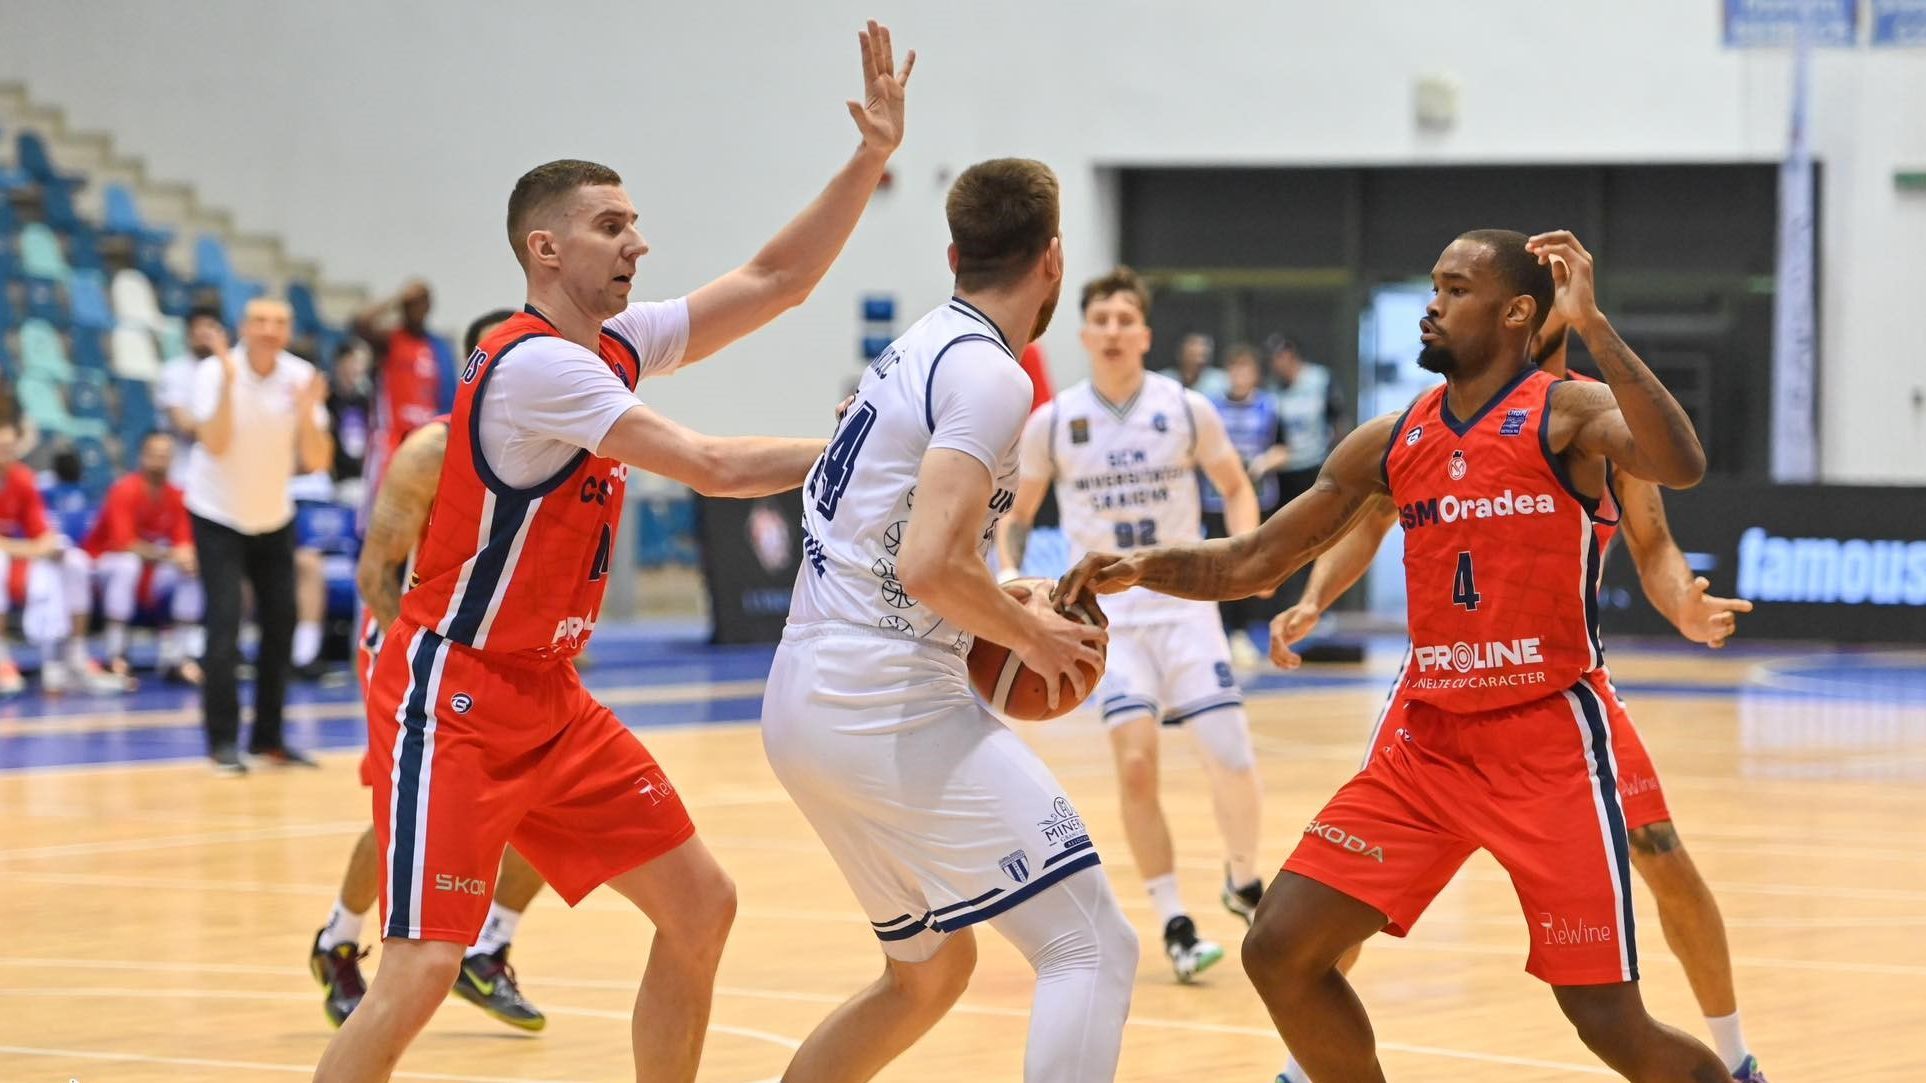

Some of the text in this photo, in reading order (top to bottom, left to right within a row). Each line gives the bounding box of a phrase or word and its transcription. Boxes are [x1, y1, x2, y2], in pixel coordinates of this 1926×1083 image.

[1114, 519, 1158, 548] 92
[1452, 551, 1481, 612] 4
[1737, 525, 1926, 605] famous
[1415, 637, 1544, 674] PROLINE
[1468, 671, 1547, 689] CARACTER
[1045, 818, 1085, 842] MINER
[1539, 911, 1611, 945] ReWine
